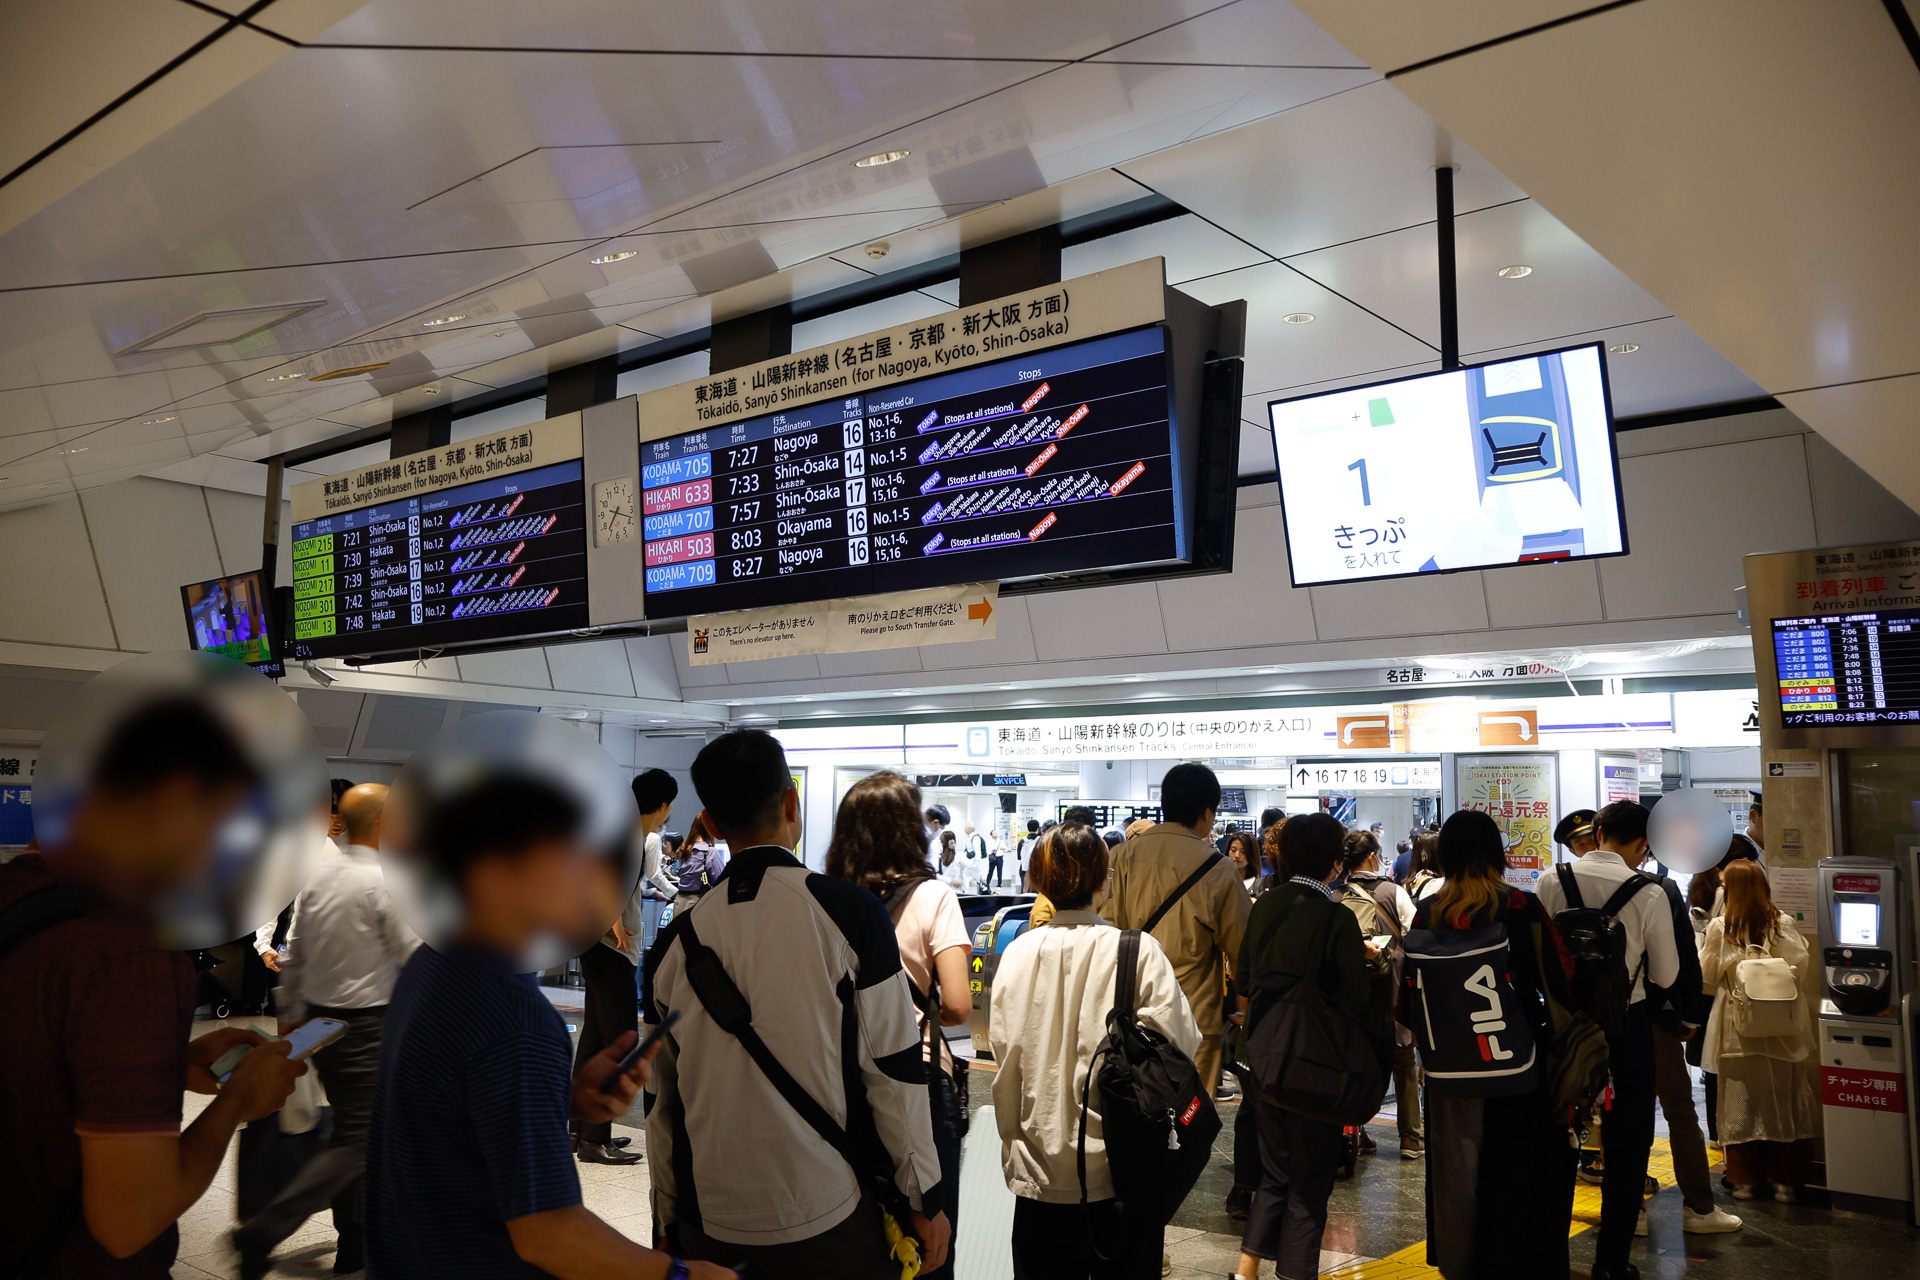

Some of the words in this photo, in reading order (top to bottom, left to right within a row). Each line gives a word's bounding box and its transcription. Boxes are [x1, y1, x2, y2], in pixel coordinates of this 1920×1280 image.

[697, 398, 743, 421] Tōkaidō,
[745, 390, 777, 413] Sanyō
[781, 379, 847, 406] Shinkansen
[852, 367, 875, 386] (for
[878, 358, 931, 380] Nagoya,
[935, 343, 980, 366] Kyōto,
[983, 316, 1069, 352] Shin-Ōsaka)
[1018, 368, 1042, 381] Stops
[843, 408, 862, 419] Tracks
[868, 397, 904, 413] Non-Reserved
[904, 397, 914, 406] Car
[918, 411, 936, 432] Tōkyō
[944, 411, 965, 425] (Stops
[966, 410, 973, 420] at
[975, 407, 983, 418] all
[984, 402, 1014, 416] stations)
[1023, 385, 1049, 411] Nagoya
[731, 433, 746, 443] Time
[773, 420, 811, 434] Destination
[774, 432, 818, 453] Nagoya
[845, 423, 862, 445] 16
[868, 412, 903, 430] No.1-6,
[869, 427, 896, 443] 13-16
[963, 426, 991, 454] Odawara
[993, 423, 1018, 449] Nagoya
[1024, 415, 1052, 443] Maibara
[1056, 406, 1087, 437] Shin-Ōsaka
[654, 450, 669, 460] Train
[683, 444, 699, 455] Train
[699, 443, 709, 451] No.
[1025, 445, 1056, 476] Shin-Ōsaka
[643, 460, 682, 480] KODAMA
[685, 456, 709, 477] 705
[729, 446, 758, 468] 7:27
[775, 455, 839, 480] Shin-Ōsaka
[846, 452, 862, 475] 14
[870, 447, 907, 466] No.1-5
[353, 488, 373, 504] Sanyō
[374, 481, 412, 501] Shinkansen
[414, 477, 426, 491] (for
[428, 472, 458, 490] Nagoya,
[460, 464, 485, 481] Kyōto,
[486, 449, 533, 473] Shin-Ōsaka)
[1347, 458, 1371, 506] 1
[646, 487, 681, 506] HIKARI
[685, 483, 710, 504] 633
[729, 473, 759, 496] 7:33
[776, 484, 840, 508] Shin-Ōsaka
[847, 481, 863, 504] 17
[871, 472, 905, 488] No.1-6,
[872, 487, 898, 502] 15,16
[965, 488, 995, 517] Shizuoka
[1077, 477, 1100, 499] Himeji
[1110, 464, 1143, 494] Okayama
[645, 514, 683, 532] KODAMA
[686, 509, 711, 531] 707
[731, 501, 761, 523] 7:57
[777, 517, 832, 536] Okayama
[848, 510, 865, 533] 16
[873, 507, 910, 525] No.1-5
[293, 539, 317, 552] NOZOMI
[317, 537, 332, 552] 215
[342, 531, 361, 547] 7:21
[369, 521, 406, 537] Shin-Ōsaka
[648, 540, 683, 557] HIKARI
[687, 537, 712, 557] 503
[731, 529, 762, 550] 8:03
[923, 534, 943, 554] Tōkyō
[1029, 514, 1056, 540] Nagoya
[1333, 517, 1407, 549] きっぷ
[294, 560, 317, 572] NOZOMI
[320, 558, 330, 572] 11
[343, 553, 362, 568] 7:30
[370, 545, 394, 558] Hakata
[779, 546, 823, 567] Nagoya
[850, 540, 866, 562] 16
[874, 532, 908, 548] No.1-6,
[875, 547, 901, 562] 15,16
[1344, 550, 1401, 570] を入れて
[294, 580, 318, 593] NOZOMI
[318, 578, 333, 593] 217
[344, 574, 362, 589] 7:39
[370, 563, 407, 580] Shin-Ōsaka
[647, 566, 686, 584] KODAMA
[688, 564, 713, 584] 709
[732, 557, 763, 578] 8:27
[295, 601, 318, 613] NOZOMI
[319, 599, 334, 614] 301
[345, 594, 363, 610] 7:42
[371, 585, 408, 600] Shin-Ōsaka
[1796, 576, 1888, 599] 到着列車
[848, 603, 962, 625] 南のりかえ口をご利用ください
[1812, 598, 1860, 612] Arrival
[295, 620, 319, 632] NOZOMI
[322, 620, 332, 633] 13
[345, 616, 364, 631] 7:48
[372, 608, 396, 622] Hakata
[713, 616, 815, 638] この先エレベーターがありません
[860, 626, 878, 635] Please
[879, 626, 886, 634] go
[895, 622, 913, 631] South
[914, 620, 938, 630] Transfer
[939, 619, 956, 627] Gate.
[730, 637, 747, 646] There's
[754, 635, 773, 644] elevator
[782, 633, 796, 641] here.
[1782, 631, 1804, 639] こだま
[1788, 687, 1811, 695] ひかり
[1817, 686, 1832, 694] 630
[1075, 743, 1135, 754] Shinkansen
[1139, 741, 1176, 752] Tracks
[1315, 769, 1329, 783] 16
[1334, 769, 1347, 783] 17
[1353, 769, 1367, 783] 18
[1373, 769, 1387, 783] 19
[661, 910, 671, 919] IC
[1464, 964, 1514, 1062] FILA
[1827, 1075, 1898, 1092] チャージ専用
[1838, 1092, 1888, 1106] CHARGE
